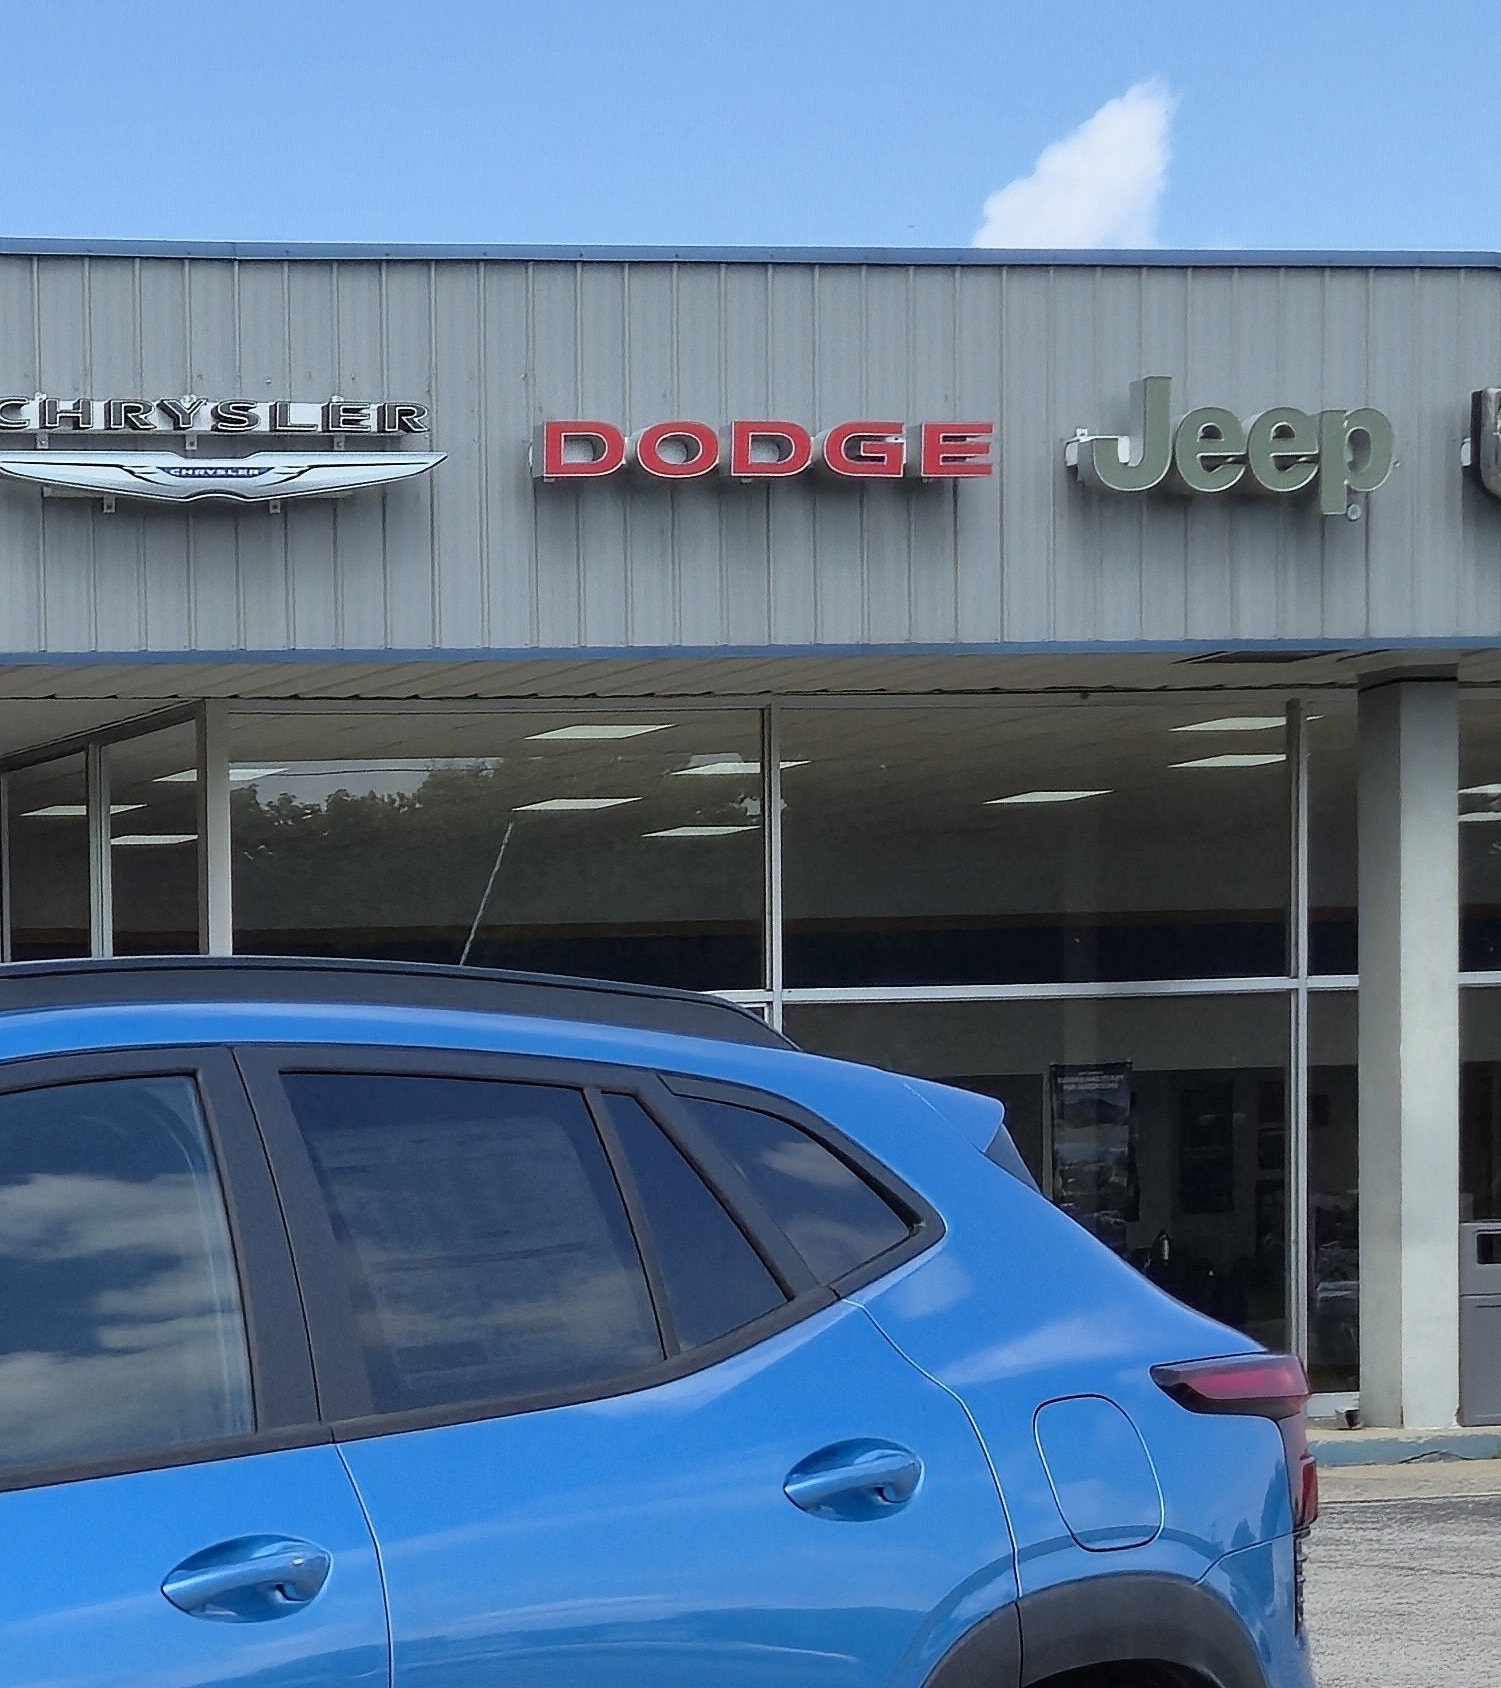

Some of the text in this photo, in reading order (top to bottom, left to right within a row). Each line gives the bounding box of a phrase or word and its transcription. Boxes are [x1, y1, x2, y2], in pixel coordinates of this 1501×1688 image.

[168, 468, 260, 477] CHRYSLER
[541, 419, 995, 479] DODGE
[1091, 375, 1394, 516] Jeep
